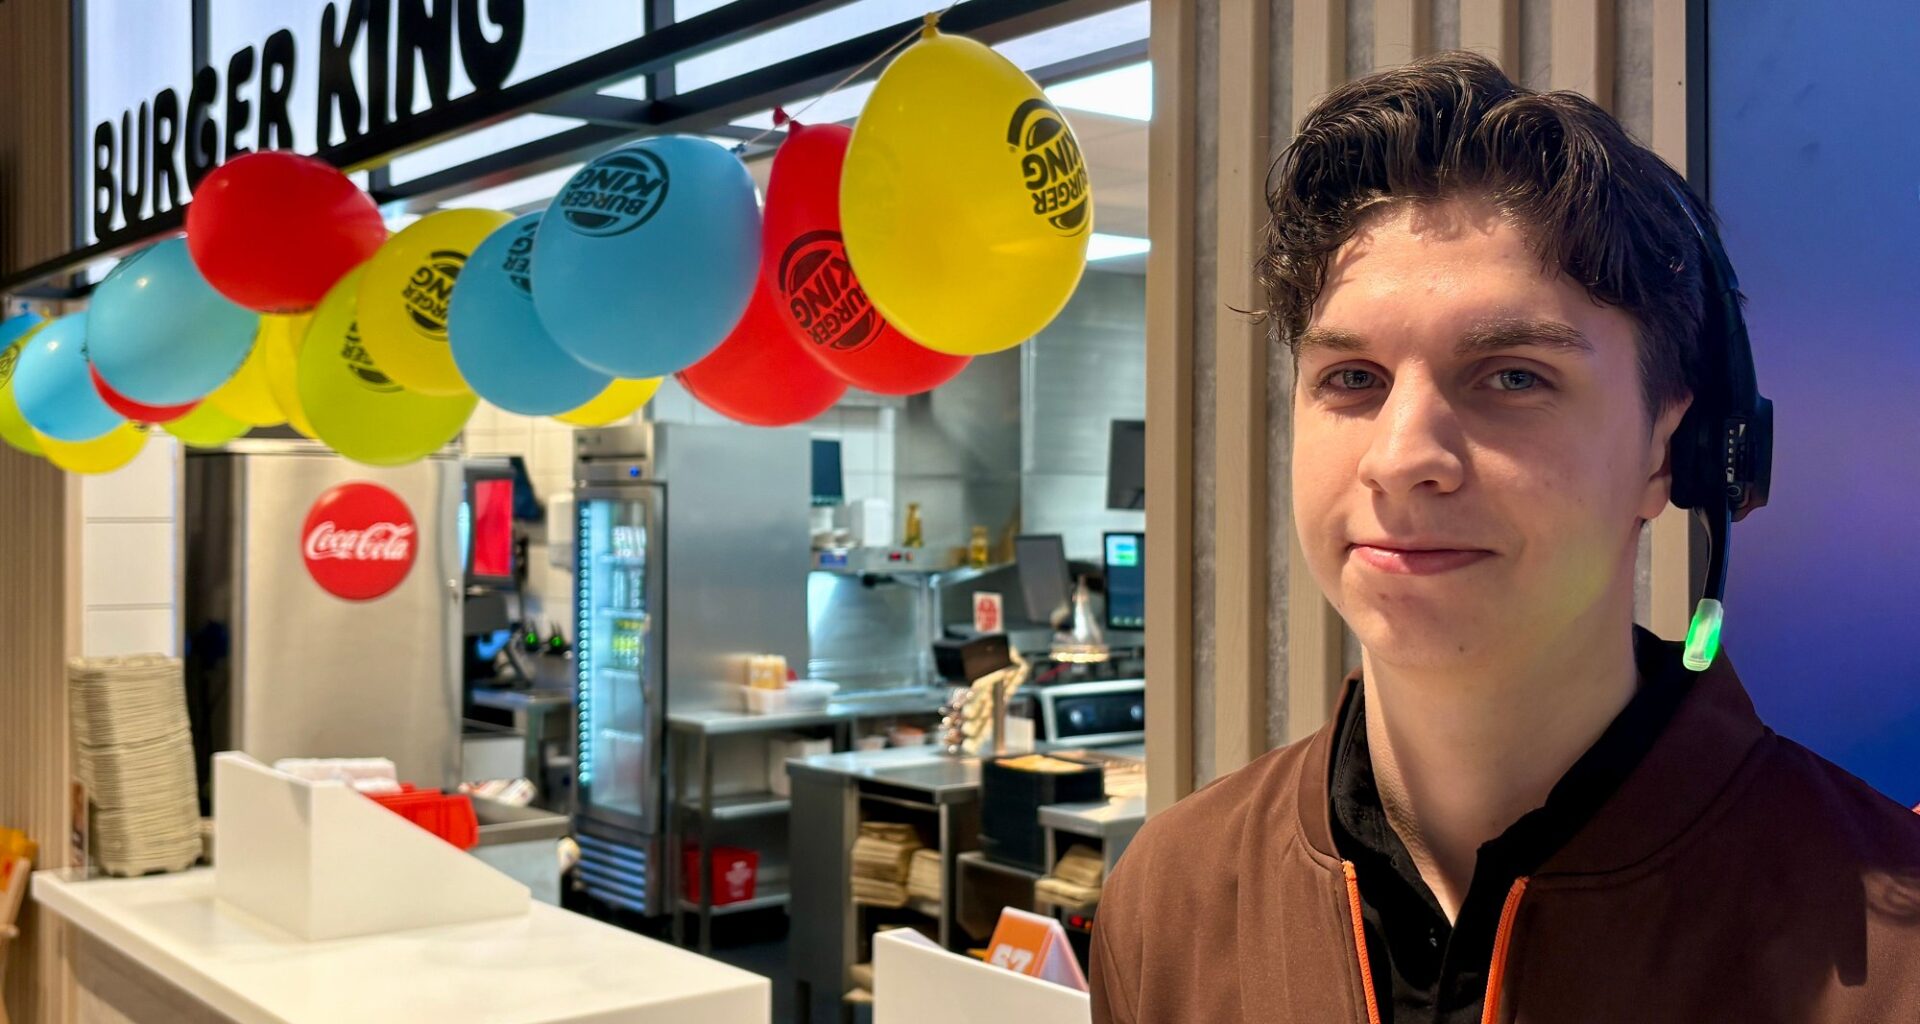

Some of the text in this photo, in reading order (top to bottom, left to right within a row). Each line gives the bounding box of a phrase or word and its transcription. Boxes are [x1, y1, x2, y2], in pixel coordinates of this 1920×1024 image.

[94, 0, 526, 240] BURGER KING
[569, 167, 663, 197] KING
[560, 190, 648, 217] BURGER
[410, 267, 453, 300] NG
[806, 287, 868, 345] URGER
